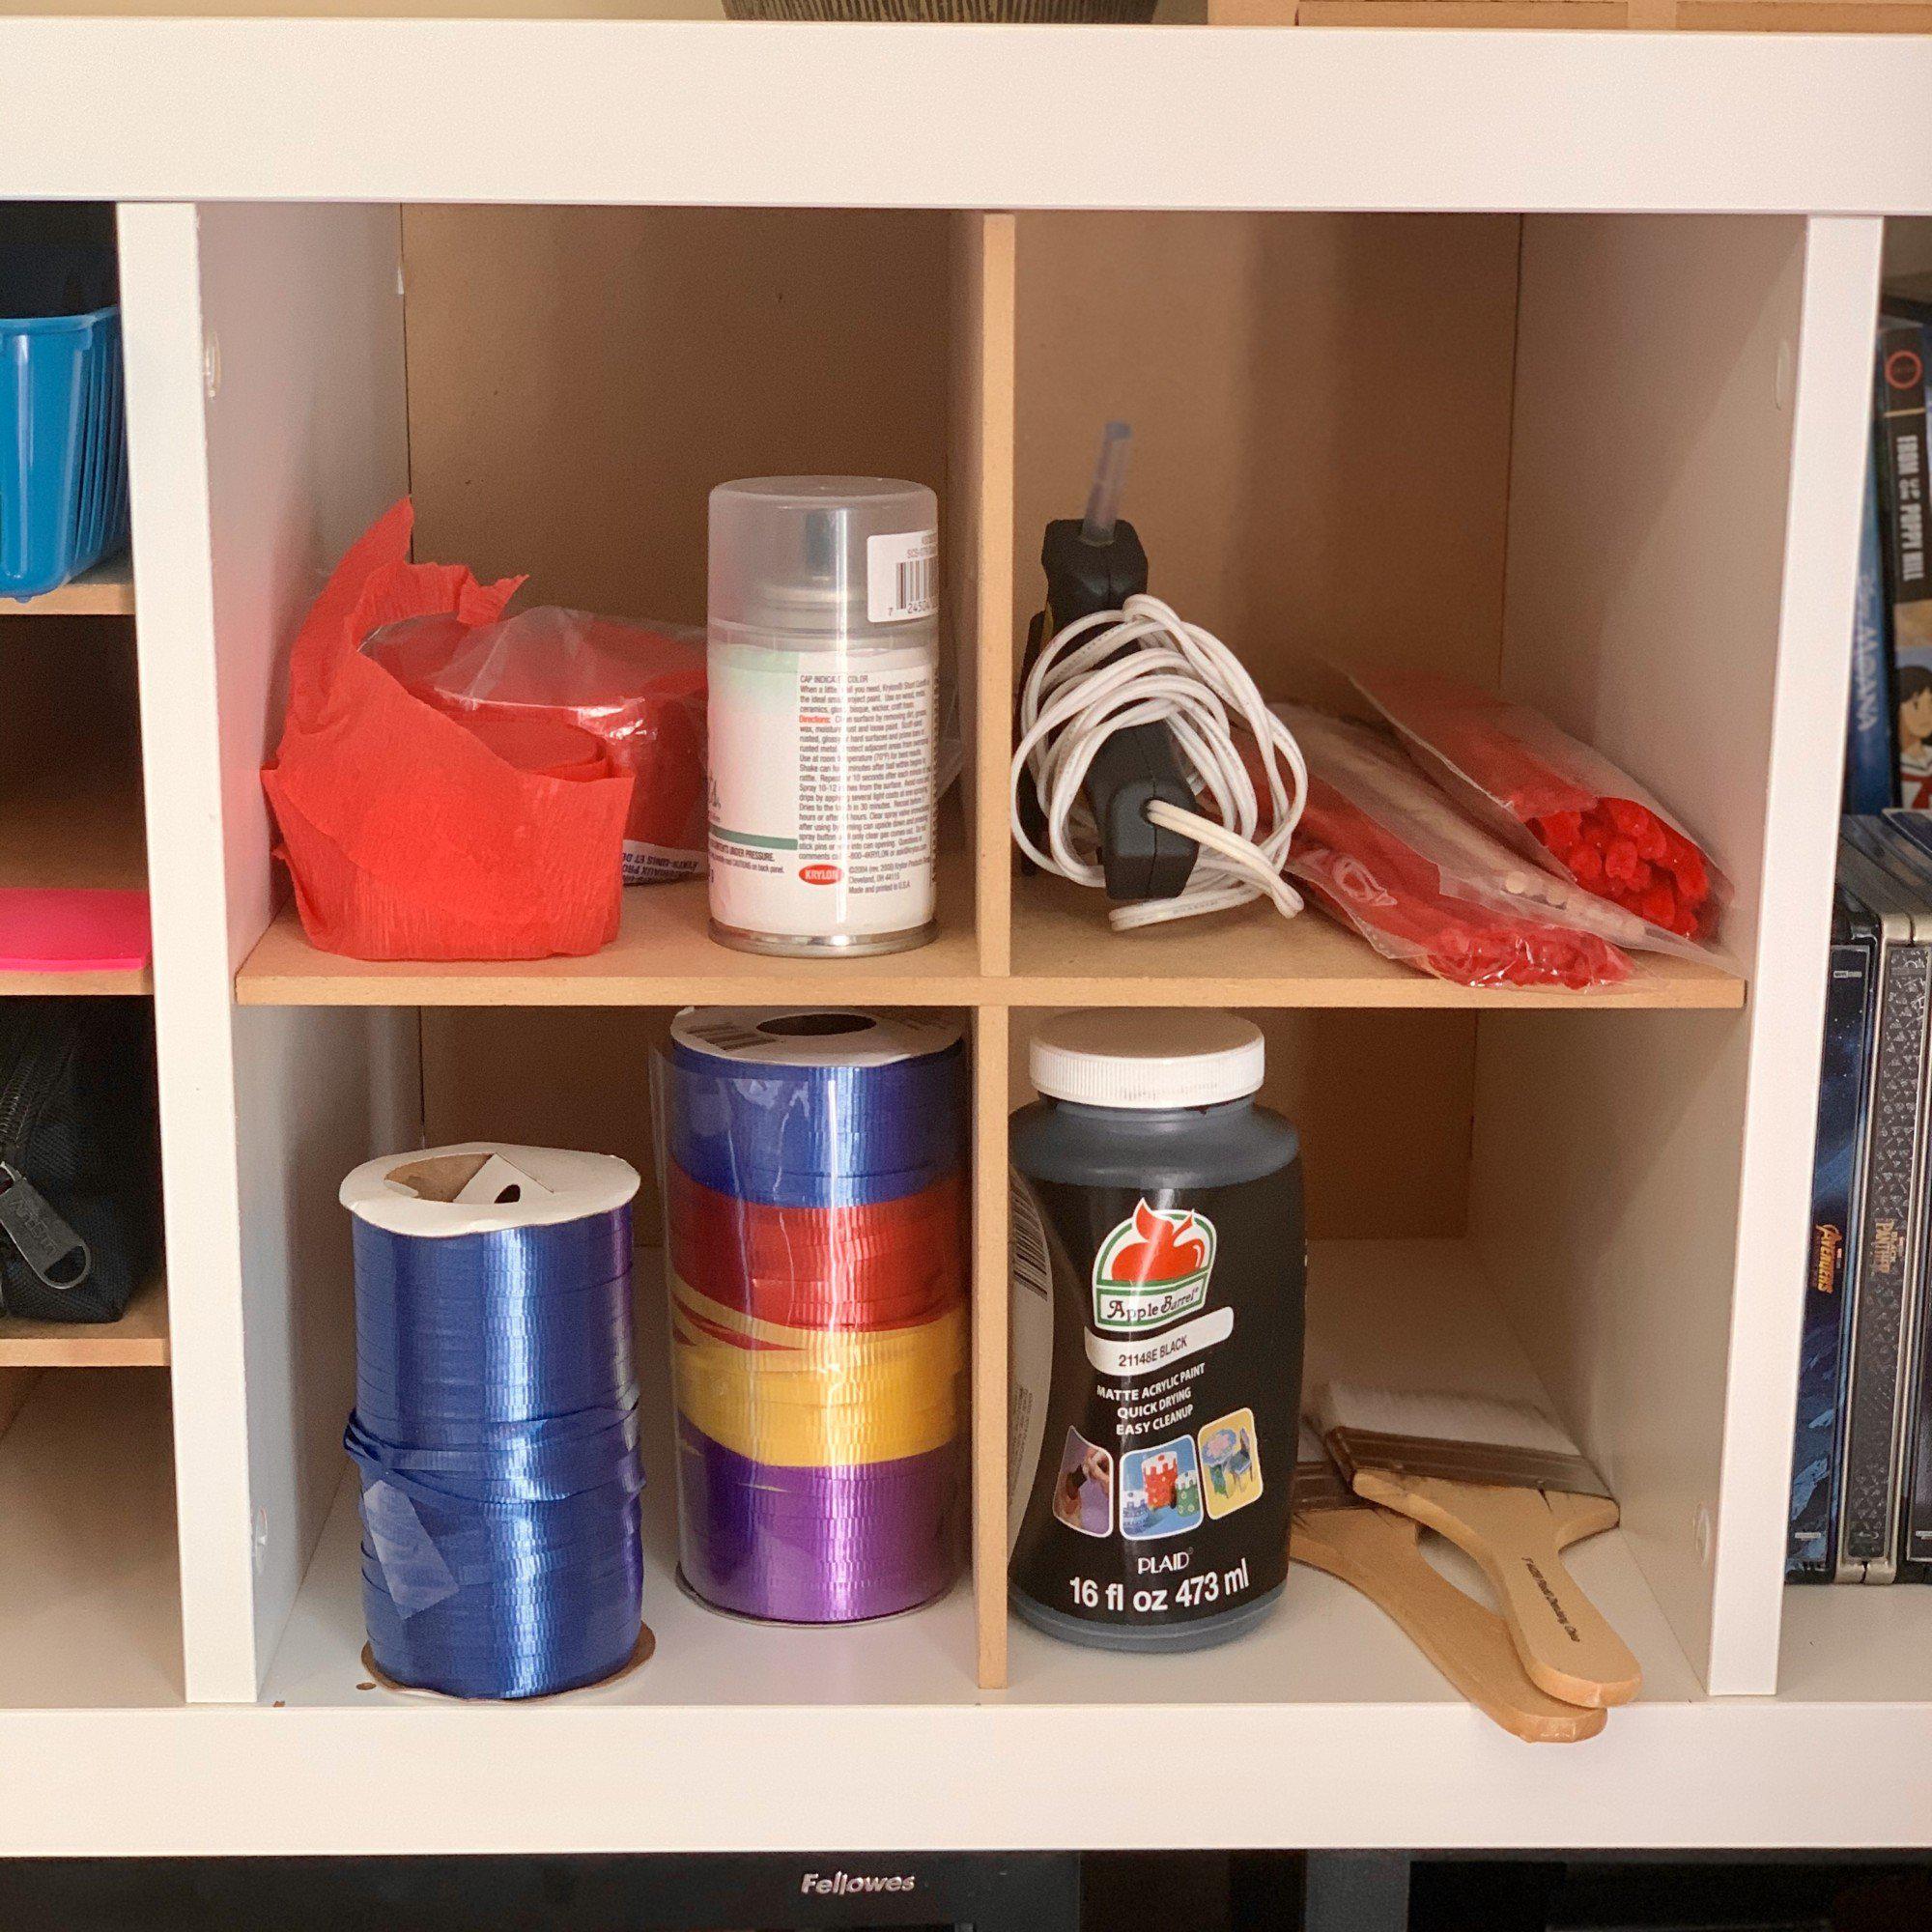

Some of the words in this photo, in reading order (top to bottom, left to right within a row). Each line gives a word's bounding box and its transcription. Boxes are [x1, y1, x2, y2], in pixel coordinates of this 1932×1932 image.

[1900, 502, 1923, 549] POPPY
[1856, 627, 1879, 732] MOANA
[846, 696, 865, 704] roject
[838, 754, 872, 763] tperature
[852, 832, 864, 840] only
[746, 849, 775, 862] PRESSURE.
[805, 869, 838, 880] KRYLON
[1815, 1224, 1842, 1293] AVENGERS
[1107, 1300, 1158, 1322] Apple
[1119, 1350, 1157, 1367] 21148E
[1160, 1335, 1187, 1358] BLACK
[1096, 1385, 1139, 1401] MATTE
[1142, 1376, 1179, 1399] ACRYLIC
[1180, 1363, 1206, 1383] PAINT
[1118, 1403, 1157, 1419] QUICK
[1159, 1387, 1191, 1411] DRYING
[1116, 1423, 1150, 1435] EASY
[1152, 1405, 1193, 1430] CLEANUP
[1070, 1577, 1098, 1607] 16
[1106, 1583, 1123, 1611] fl
[1133, 1590, 1168, 1612] oz
[1176, 1572, 1219, 1607] 473
[1224, 1557, 1250, 1595] ml
[801, 1870, 915, 1894] Fellowes
